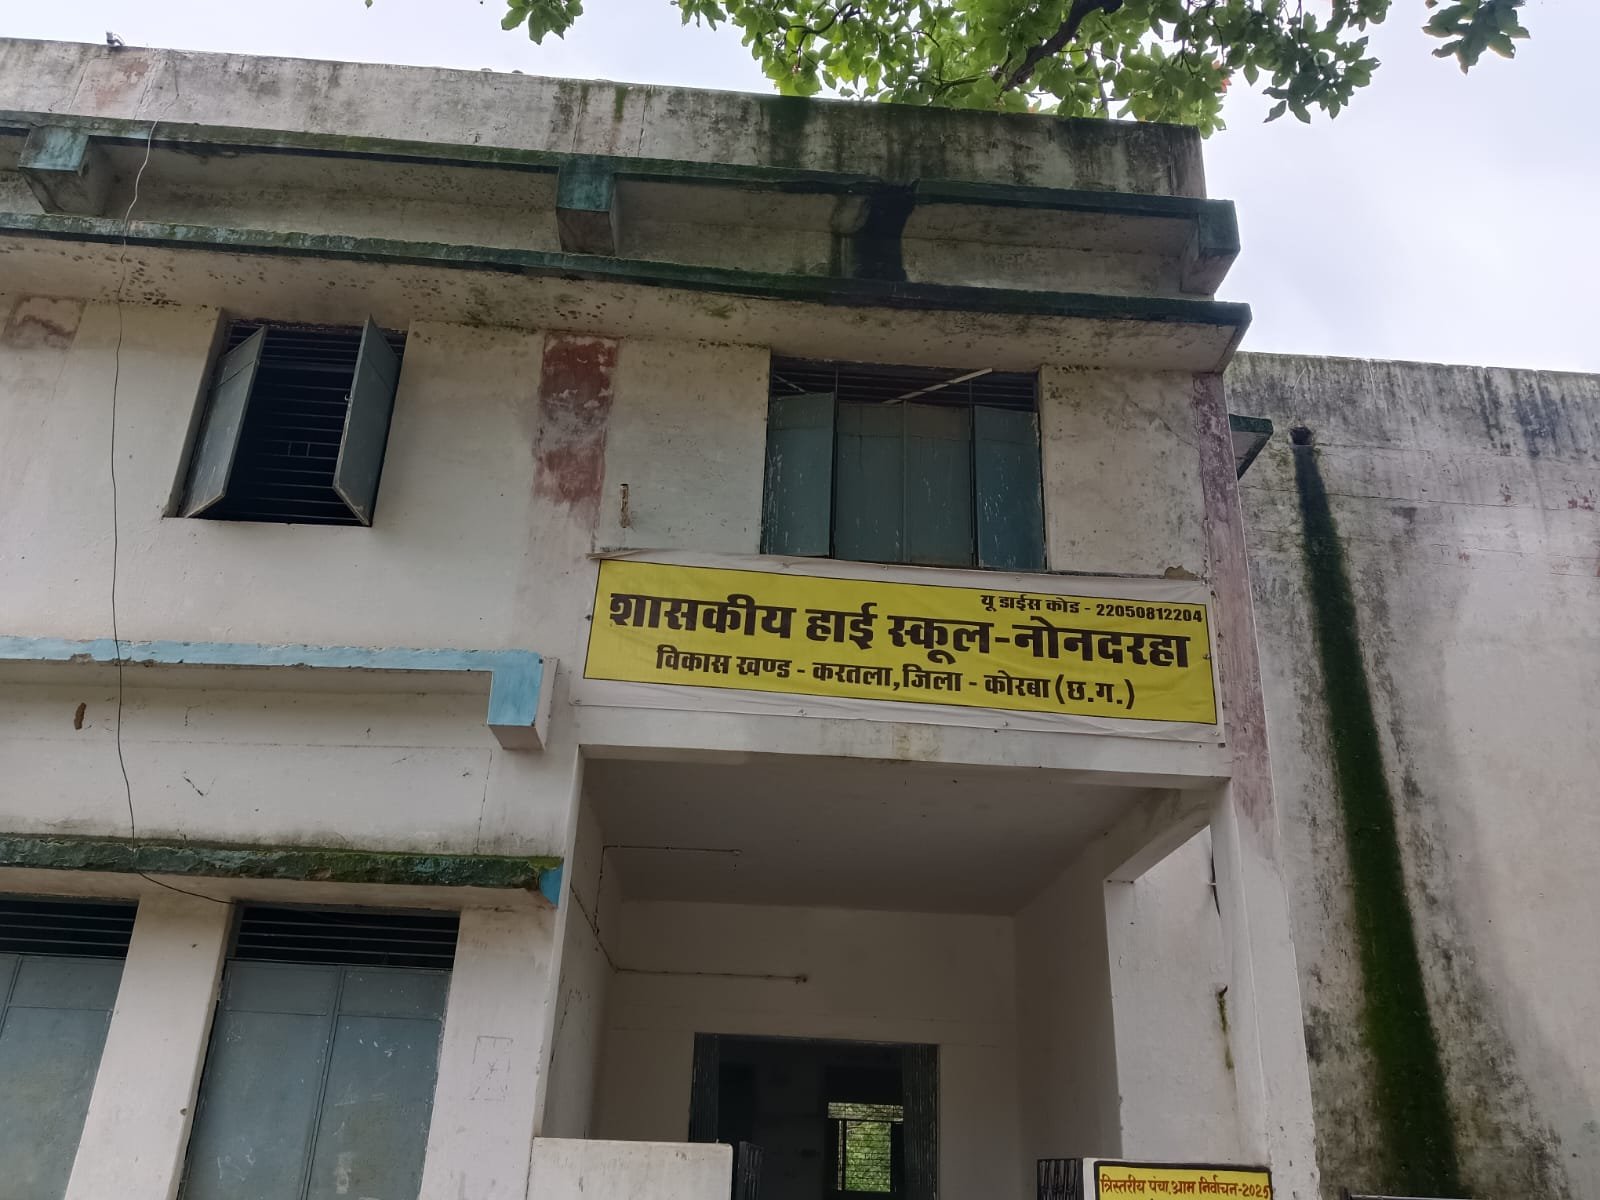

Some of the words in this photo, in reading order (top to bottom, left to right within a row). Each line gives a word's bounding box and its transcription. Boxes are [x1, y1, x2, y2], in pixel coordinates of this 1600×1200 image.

[609, 592, 797, 639] शासकीय
[805, 602, 878, 650] हाई
[980, 594, 997, 612] यू
[999, 594, 1041, 611] डाईस
[1046, 597, 1080, 613] कोड
[1096, 603, 1202, 622] 22050812204
[656, 644, 732, 674] विकास
[736, 656, 792, 678] खण्ड
[1101, 1174, 1146, 1195] त्रिस्तरीय
